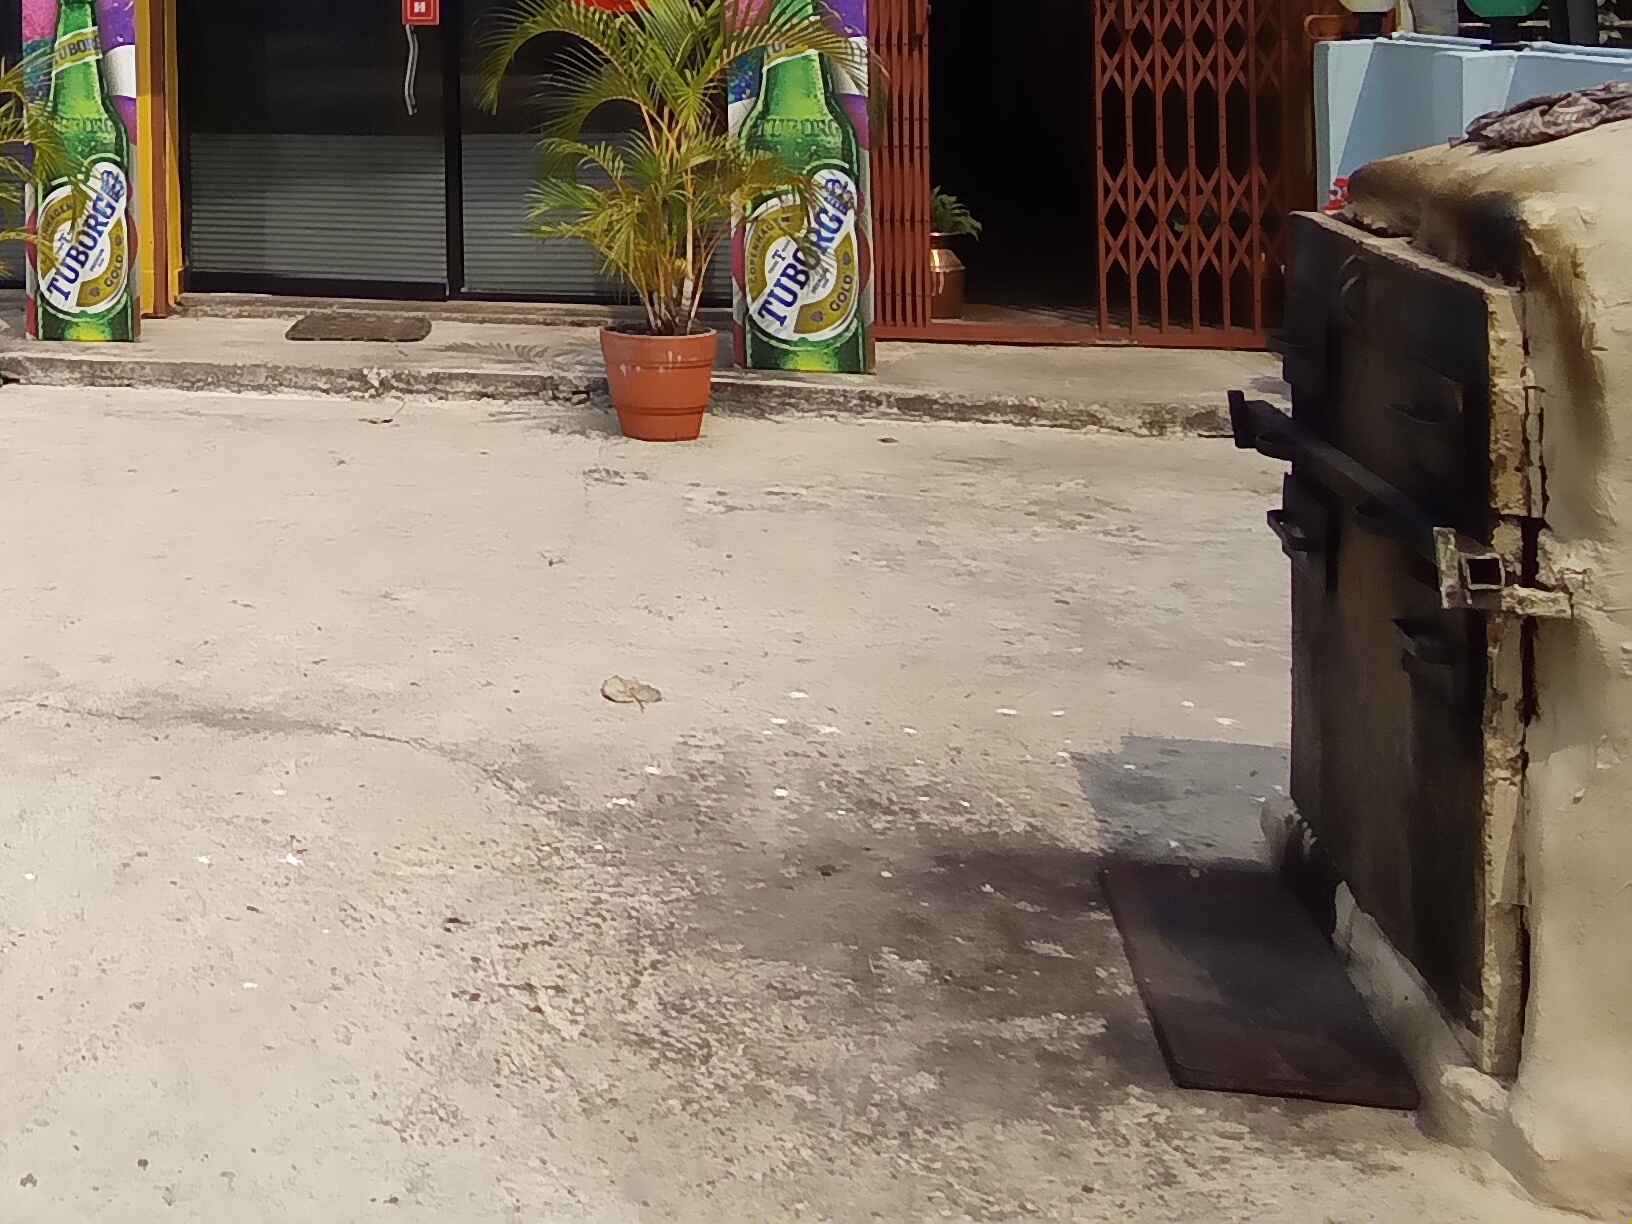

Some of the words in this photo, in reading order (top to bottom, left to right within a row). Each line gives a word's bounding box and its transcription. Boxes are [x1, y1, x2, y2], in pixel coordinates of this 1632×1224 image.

[46, 193, 117, 302] TUBORG
[103, 253, 125, 288] GOLD
[828, 273, 854, 313] GOLD
